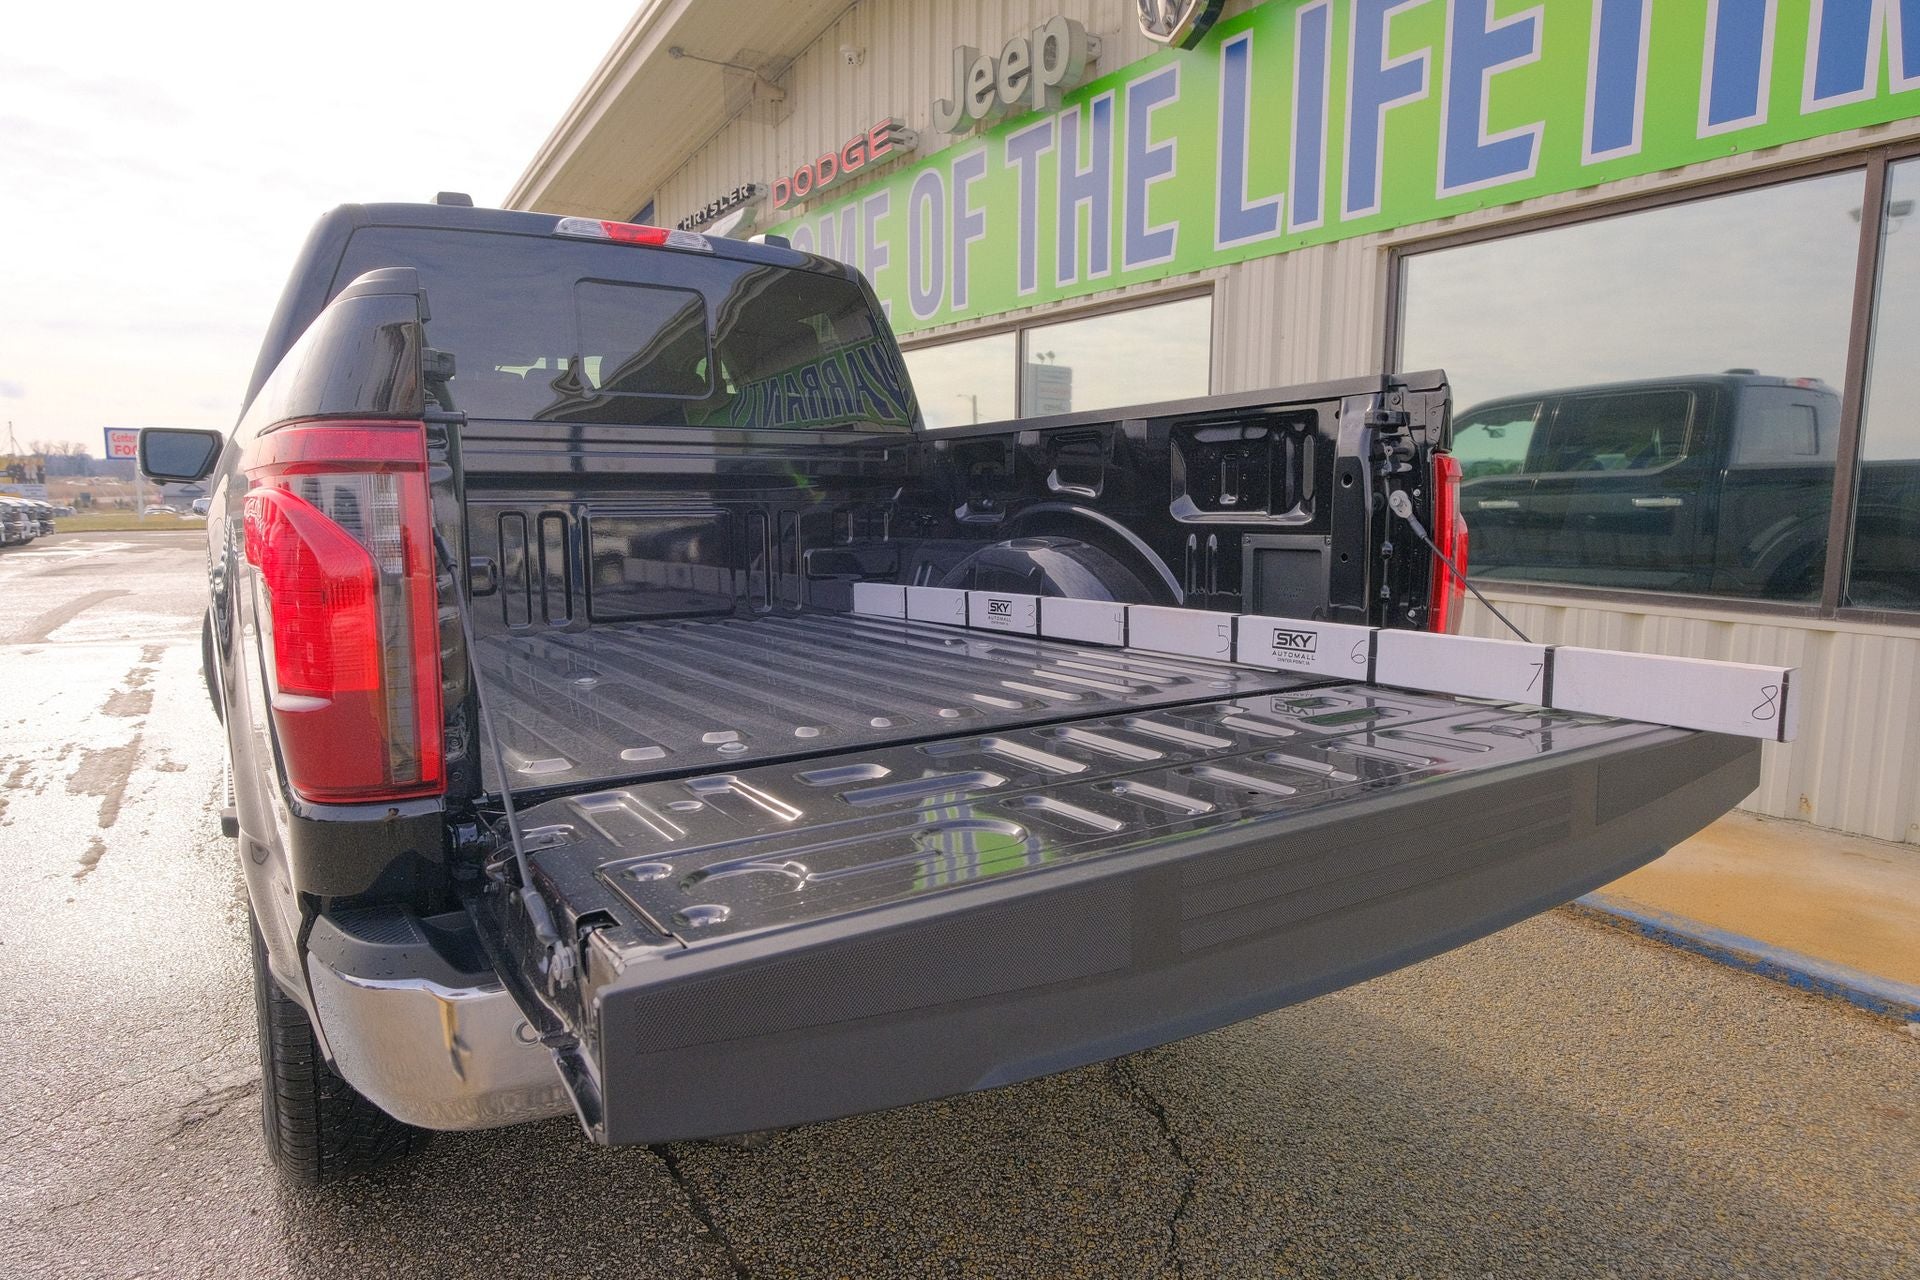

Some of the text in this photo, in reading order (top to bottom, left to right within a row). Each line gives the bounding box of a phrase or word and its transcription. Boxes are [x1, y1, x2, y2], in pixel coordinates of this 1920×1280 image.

[933, 15, 1072, 134] Jeep
[771, 118, 893, 209] DODGE
[907, 145, 988, 321] OF
[1004, 60, 1180, 298] THE
[955, 597, 965, 616] 2
[990, 602, 1010, 613] SKY
[1025, 604, 1036, 628] 3
[1114, 613, 1124, 641] 4
[1216, 624, 1230, 653] 5
[1276, 632, 1313, 648] SKY
[1272, 650, 1316, 661] AUTOMALL
[1351, 640, 1366, 664] 6
[1526, 662, 1543, 691] 7
[1752, 685, 1778, 720] 8
